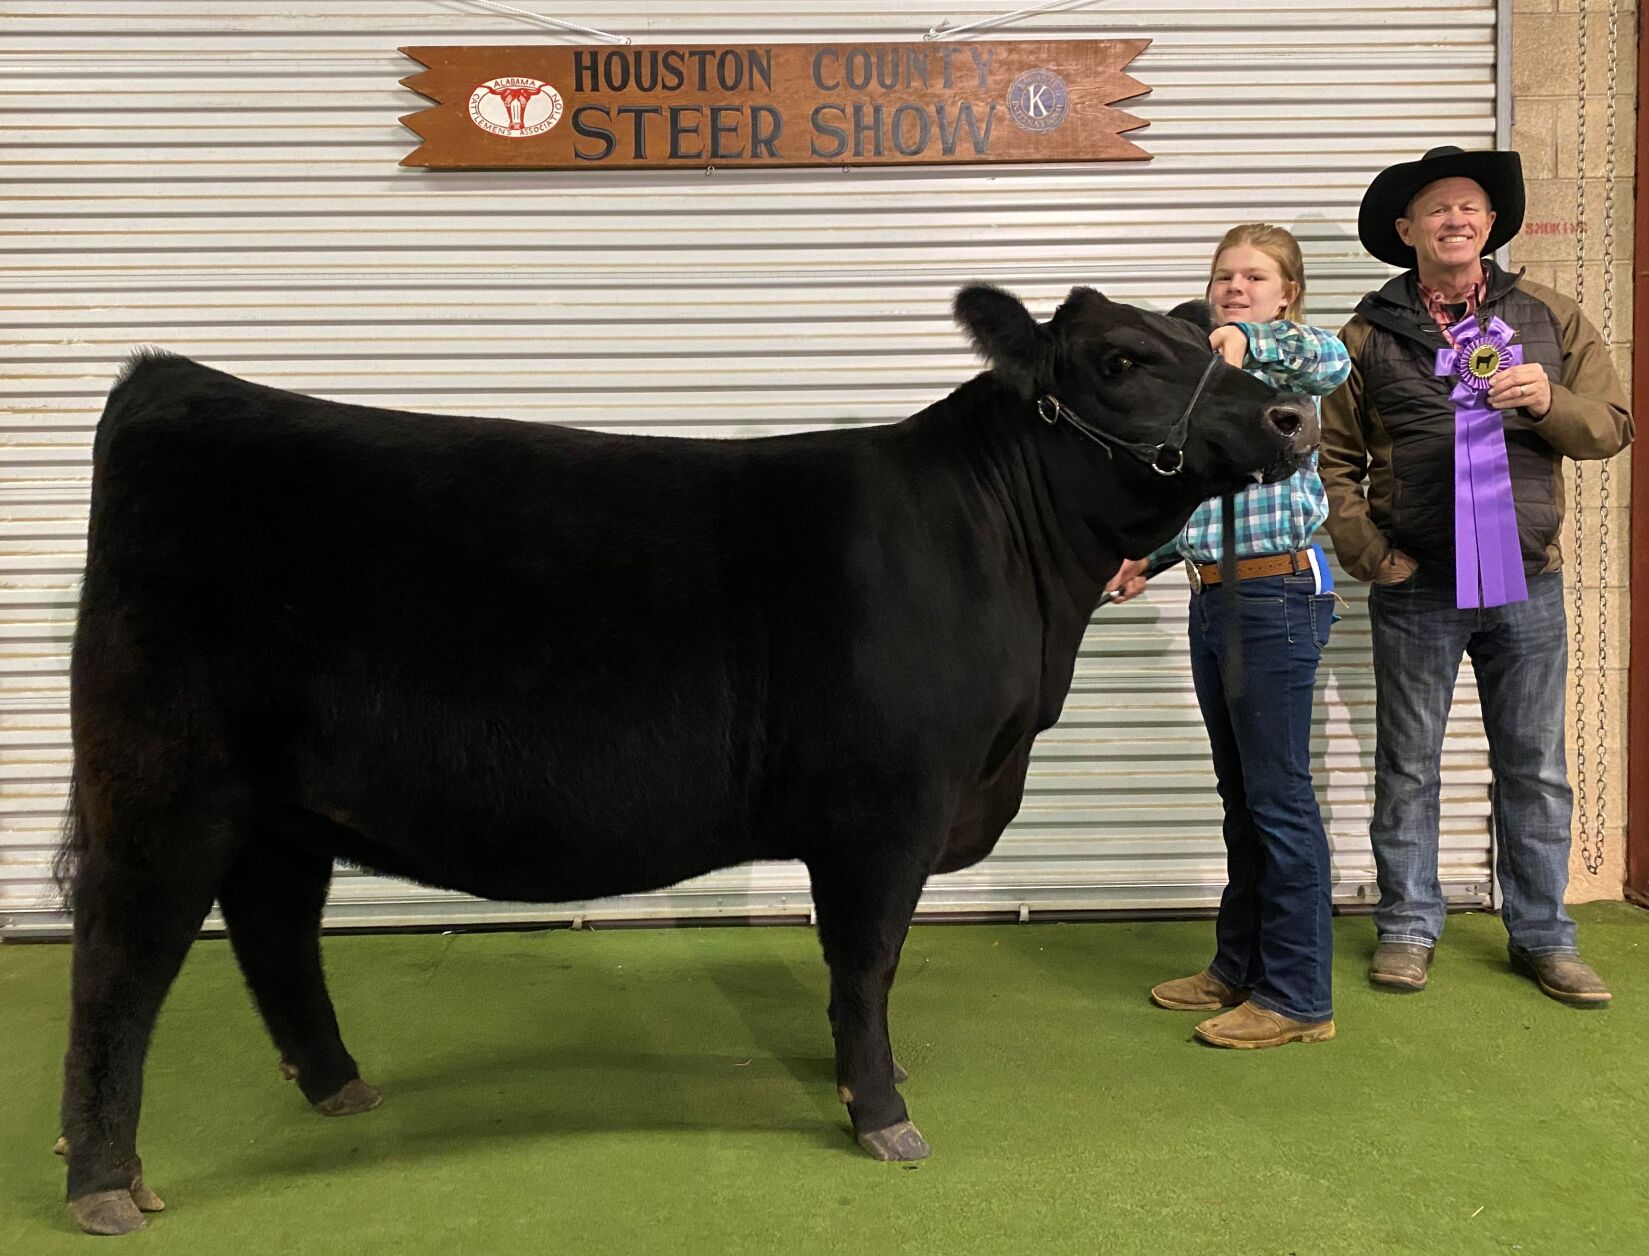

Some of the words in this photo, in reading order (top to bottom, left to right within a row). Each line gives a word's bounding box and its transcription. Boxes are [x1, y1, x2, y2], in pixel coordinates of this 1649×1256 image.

[493, 78, 537, 88] ALABAMA
[573, 50, 773, 93] HOUSTON
[812, 47, 998, 92] COUNTY
[519, 93, 563, 136] ASSOCIATION
[1028, 85, 1049, 117] K
[573, 104, 784, 161] STEER
[811, 102, 998, 159] SHOW
